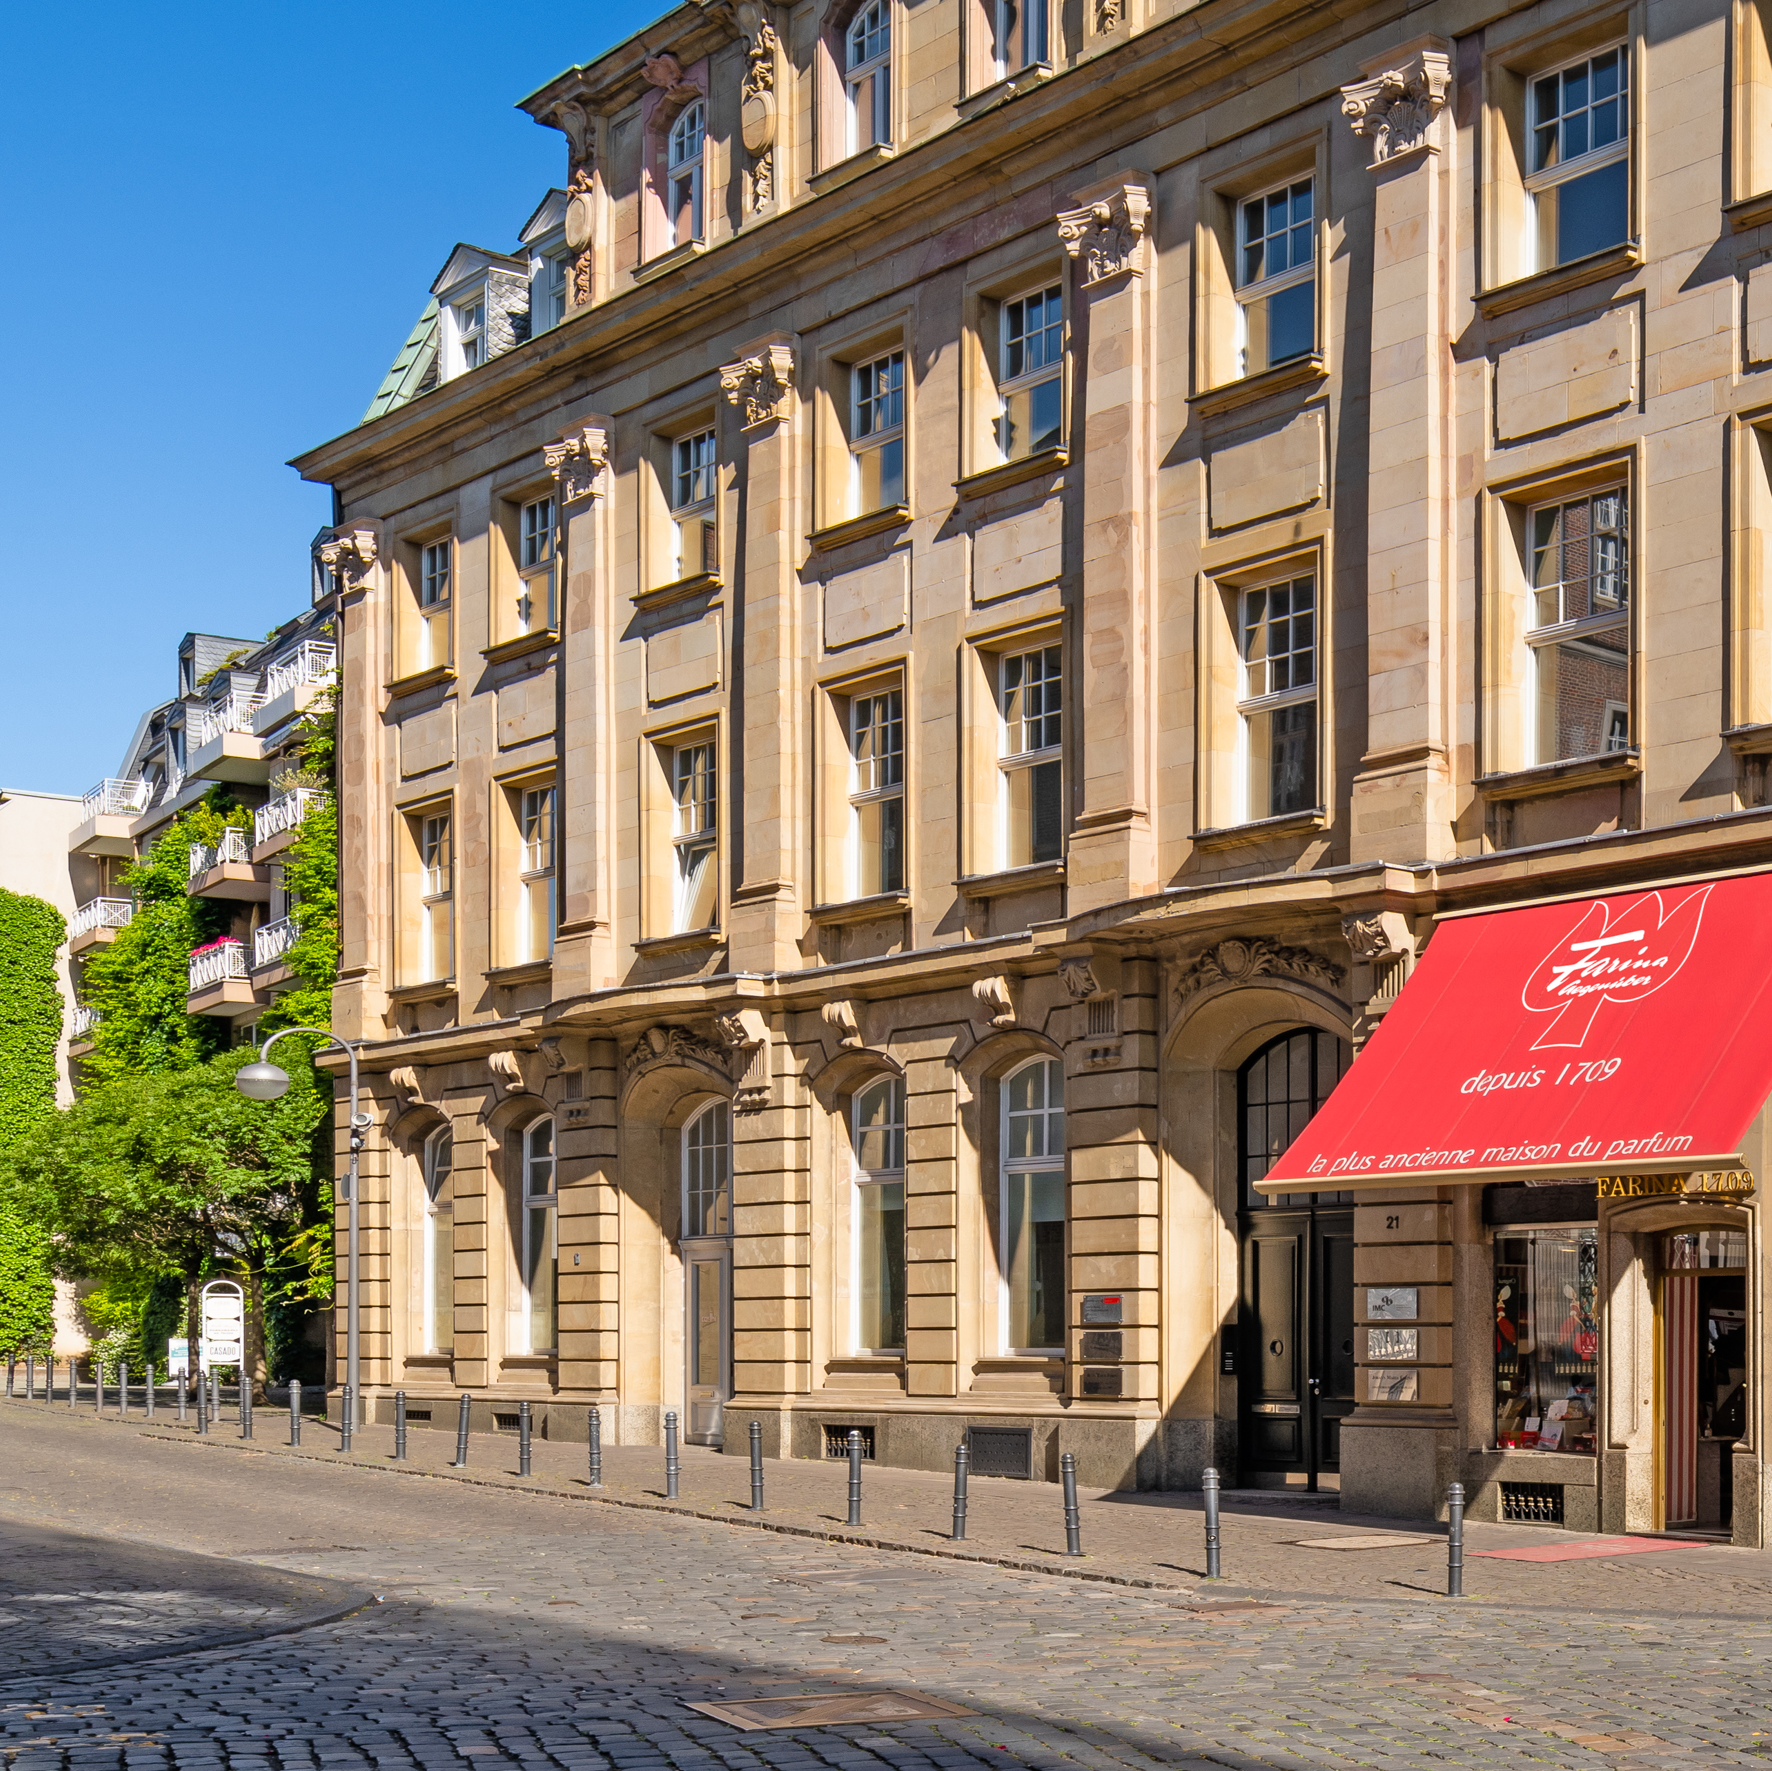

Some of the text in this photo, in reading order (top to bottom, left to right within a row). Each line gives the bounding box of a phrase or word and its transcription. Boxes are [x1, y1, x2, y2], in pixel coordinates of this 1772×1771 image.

[1546, 929, 1668, 992] Farina
[1460, 1057, 1622, 1096] depuis 1709
[1306, 1132, 1693, 1176] la plus ancienne maison du parfum
[1596, 1171, 1755, 1198] FARINA 1709
[1386, 1215, 1400, 1229] 21
[209, 1346, 236, 1355] CASADO
